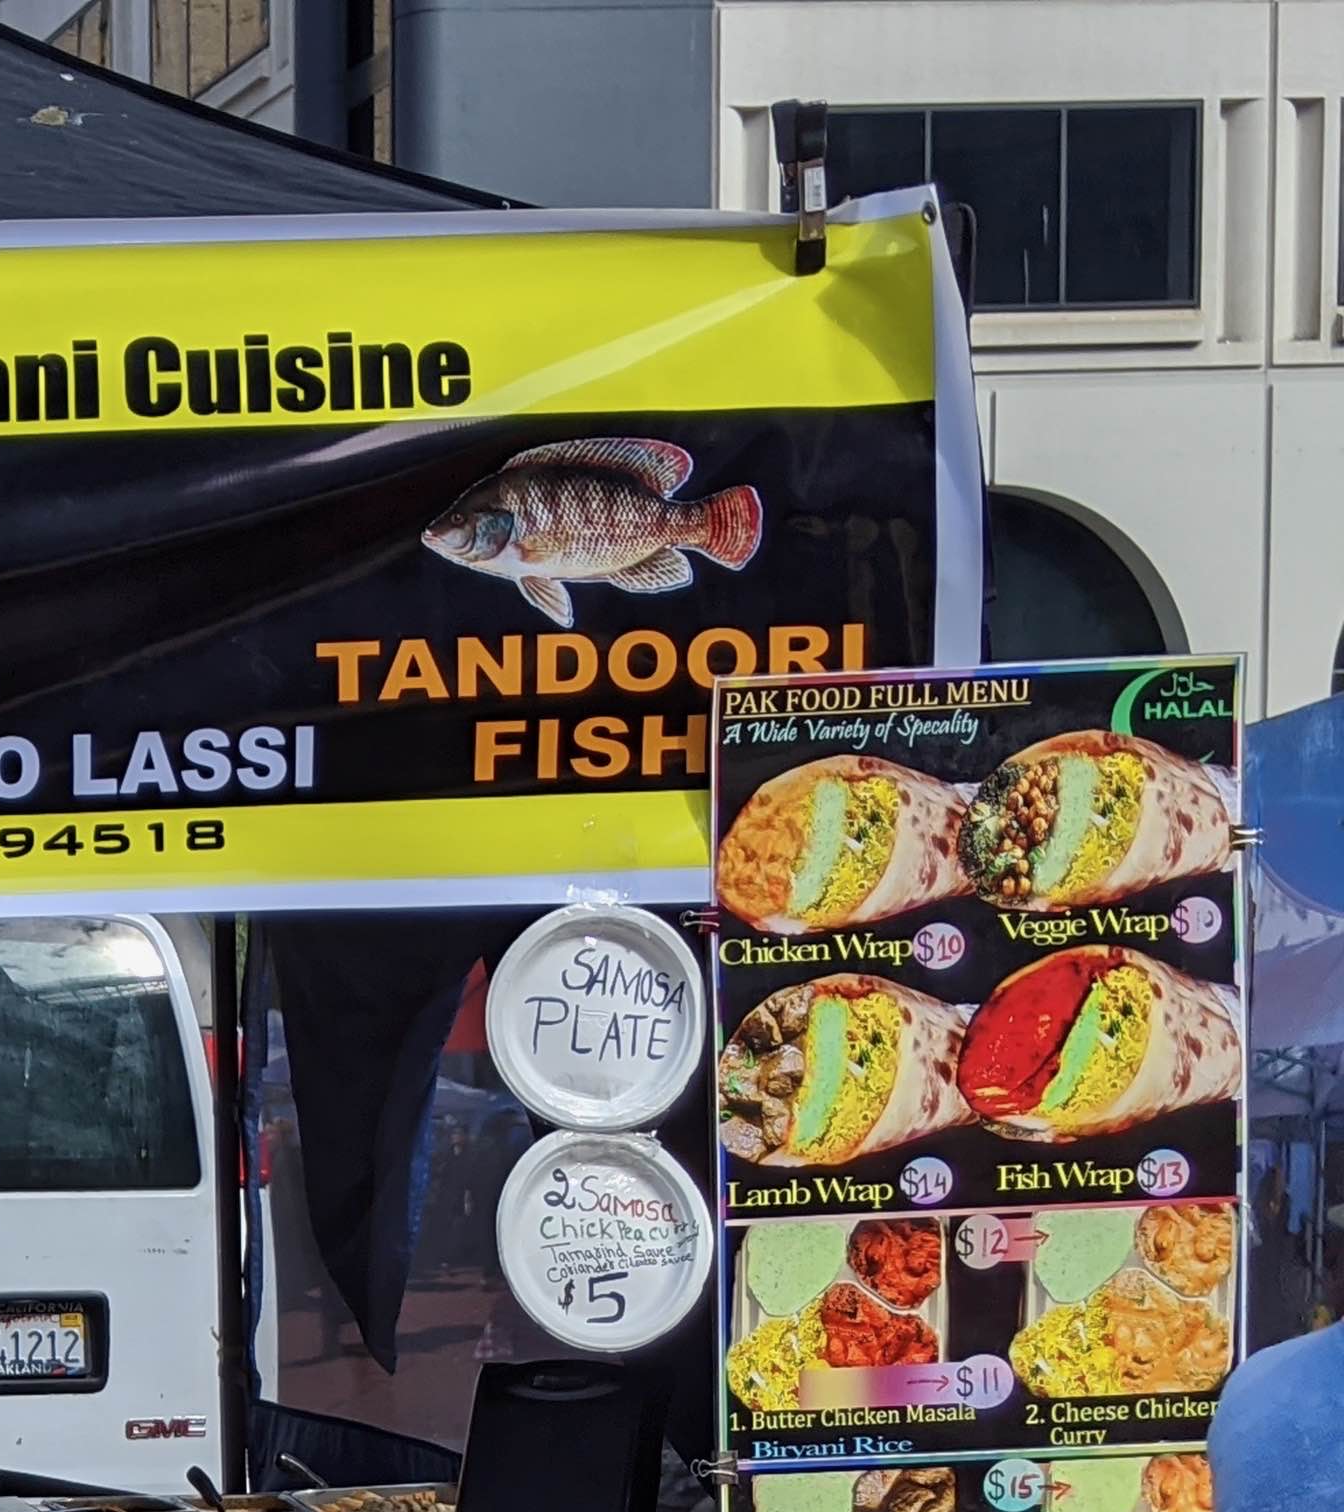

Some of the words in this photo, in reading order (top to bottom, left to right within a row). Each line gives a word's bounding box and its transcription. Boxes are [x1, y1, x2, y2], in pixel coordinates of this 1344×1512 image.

[124, 331, 471, 417] Cuisine
[316, 624, 865, 702] TANDOORI
[1144, 701, 1232, 720] HALAL
[72, 725, 315, 797] LASSI
[474, 715, 706, 783] FISH
[561, 949, 685, 1014] SAMOSA
[524, 996, 672, 1062] PLATE
[727, 1181, 811, 1207] Lamb
[813, 1178, 893, 1210] Wrap
[997, 1163, 1051, 1191] Fish
[1057, 1163, 1134, 1195] Wrap
[125, 1415, 207, 1440] GMC
[988, 1469, 1039, 1500] $15
